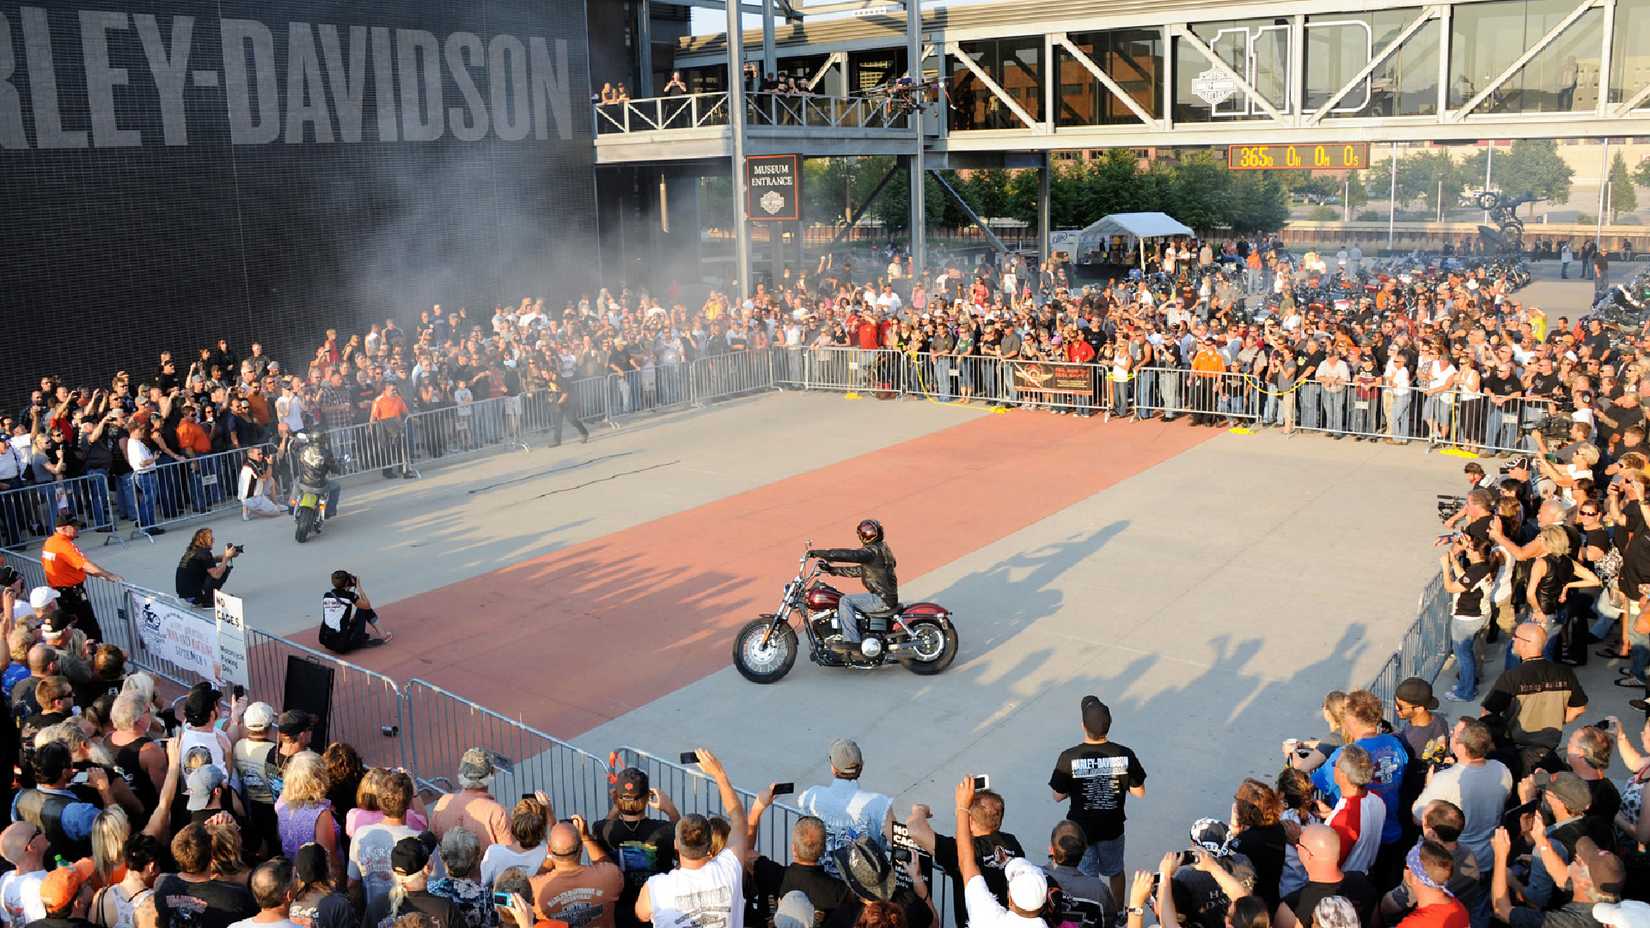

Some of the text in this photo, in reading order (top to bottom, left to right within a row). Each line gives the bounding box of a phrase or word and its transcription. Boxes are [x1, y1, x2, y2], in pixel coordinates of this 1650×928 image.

[753, 164, 789, 175] MUSEUM
[751, 176, 793, 187] ENTRANCE
[217, 610, 240, 628] CAGES
[893, 825, 909, 837] NO
